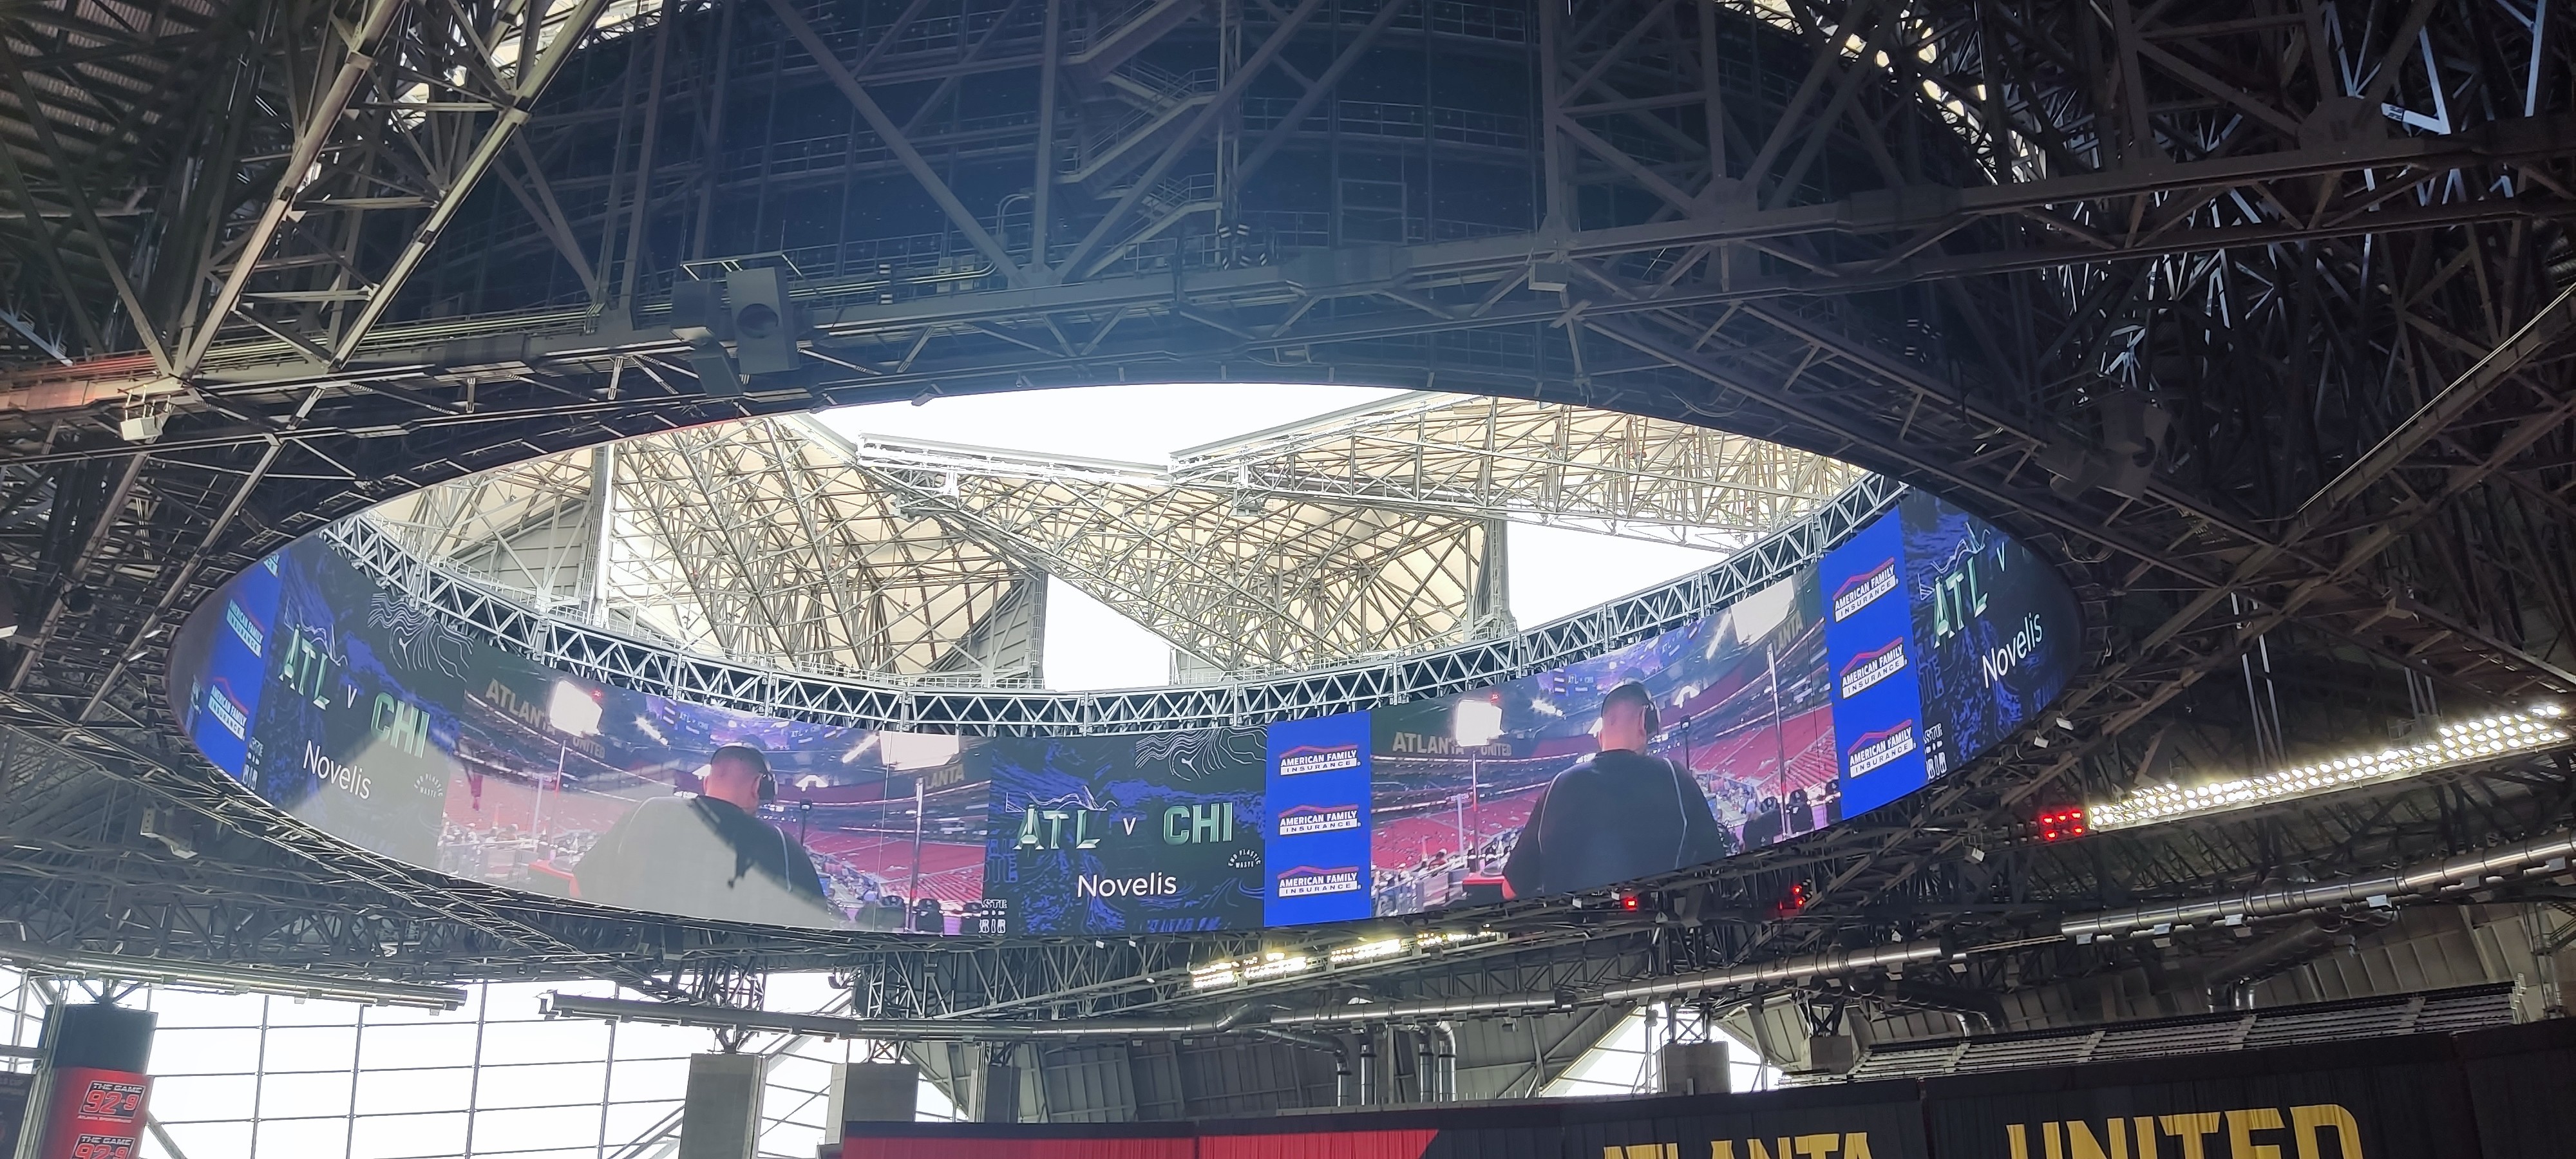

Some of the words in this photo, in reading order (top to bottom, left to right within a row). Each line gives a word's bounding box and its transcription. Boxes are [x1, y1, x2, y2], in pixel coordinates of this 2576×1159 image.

[1835, 581, 1870, 611] AMERICAN
[1871, 565, 1894, 589] FAMILY
[1841, 581, 1891, 617] INSURANCE
[1934, 557, 1988, 648] ATL
[1842, 660, 1877, 688] AMERICAN
[1879, 645, 1902, 667] FAMILY
[1982, 612, 2043, 688] Novelis
[279, 624, 330, 710] ATL
[371, 692, 430, 759] CHI
[1848, 660, 1899, 693] INSURANCE
[230, 706, 247, 727] FAMILY
[486, 678, 556, 735] ATLAN
[1280, 754, 1325, 767] AMERICAN
[1327, 749, 1357, 762] FAMILY
[1850, 740, 1886, 766] AMERICAN
[1888, 727, 1911, 748] FAMILY
[1855, 743, 1908, 773] INSURANCE
[303, 740, 372, 799] Novelis
[1287, 760, 1350, 773] INSURANCE
[1012, 804, 1101, 850] ATL
[1163, 802, 1233, 845] CHI
[1280, 814, 1325, 827] AMERICAN
[1327, 810, 1358, 822] FAMILY
[1286, 821, 1351, 832] INSURANCE
[1077, 872, 1177, 898] Novelis
[1279, 876, 1325, 888] AMERICAN
[1327, 872, 1358, 883] FAMILY
[1285, 883, 1351, 894] INSURANCE
[113, 1085, 142, 1093] GAME
